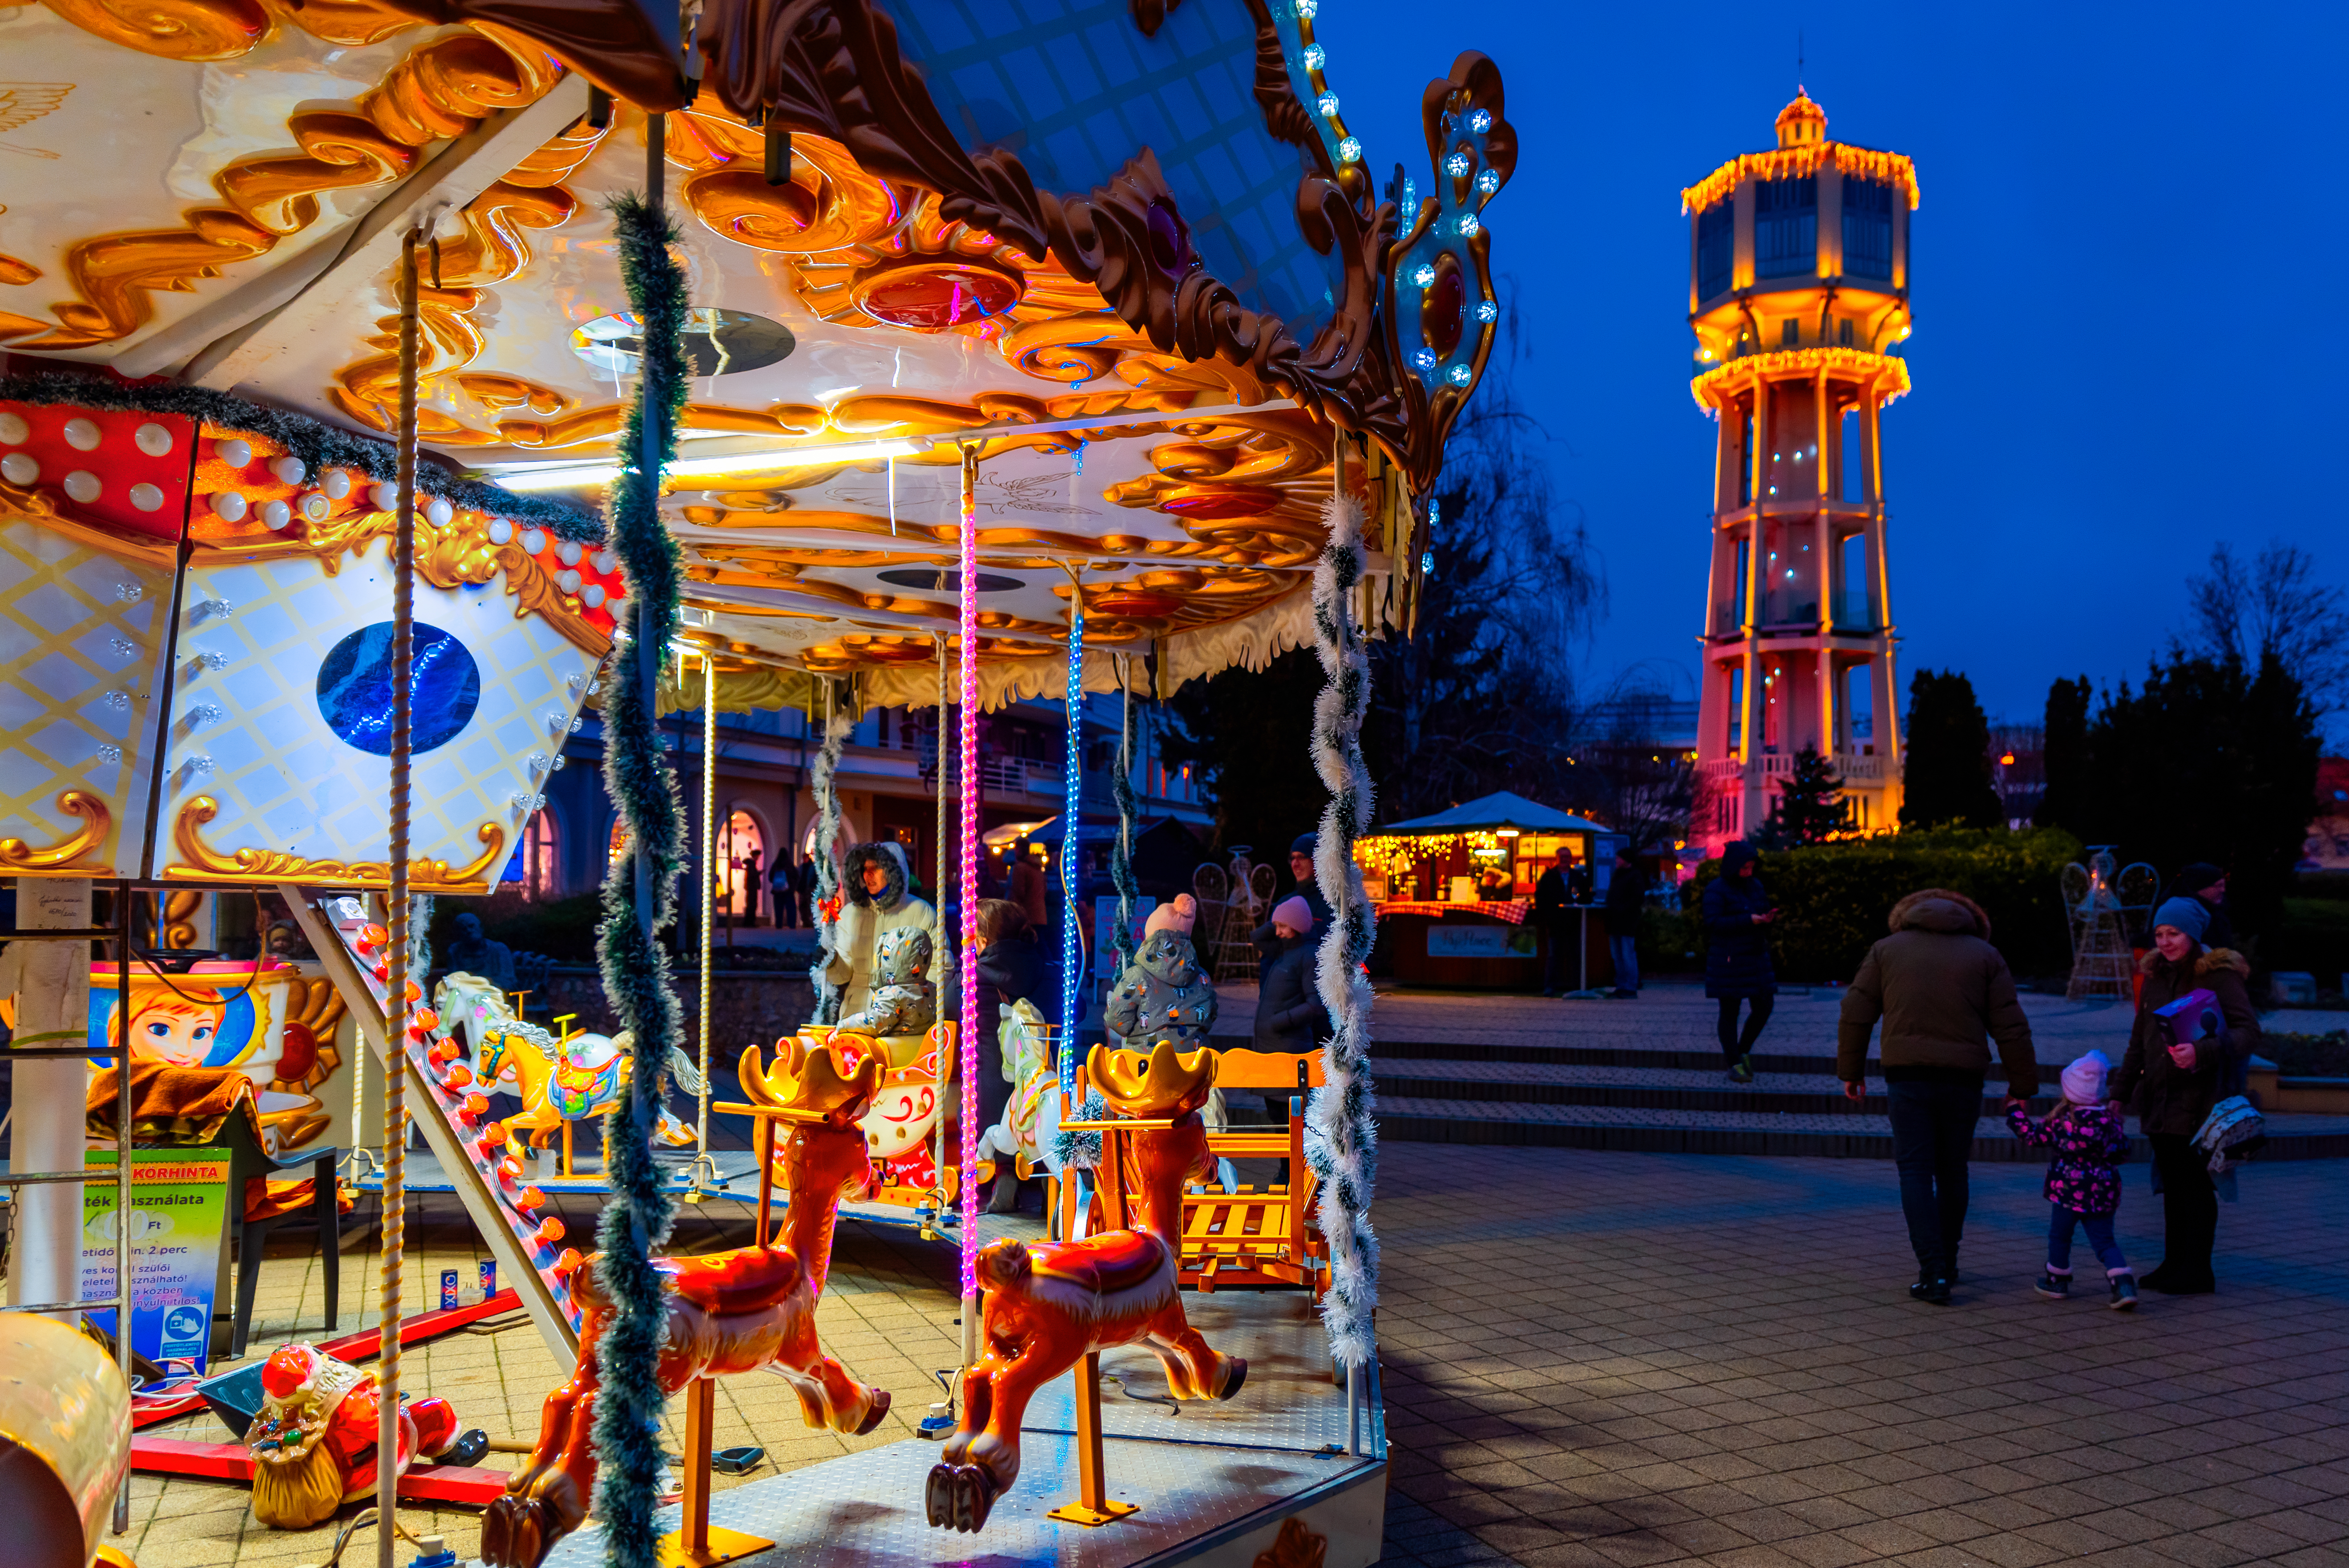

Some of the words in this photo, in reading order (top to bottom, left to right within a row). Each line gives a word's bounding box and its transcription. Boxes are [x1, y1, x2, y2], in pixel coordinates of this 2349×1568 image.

[133, 1166, 218, 1179] KÖRHINTA
[85, 1196, 111, 1207] ték
[130, 1194, 204, 1206] asználata
[148, 1221, 161, 1229] Ft
[82, 1247, 114, 1257] etidő
[131, 1247, 144, 1255] in.
[149, 1246, 156, 1254] 2
[160, 1246, 187, 1256] perc
[138, 1264, 170, 1273] szülői
[82, 1278, 113, 1286] eletel
[131, 1275, 187, 1284] sználható!
[143, 1287, 183, 1295] közben
[445, 1275, 456, 1305] XIXO
[174, 1297, 199, 1305] tilos!
